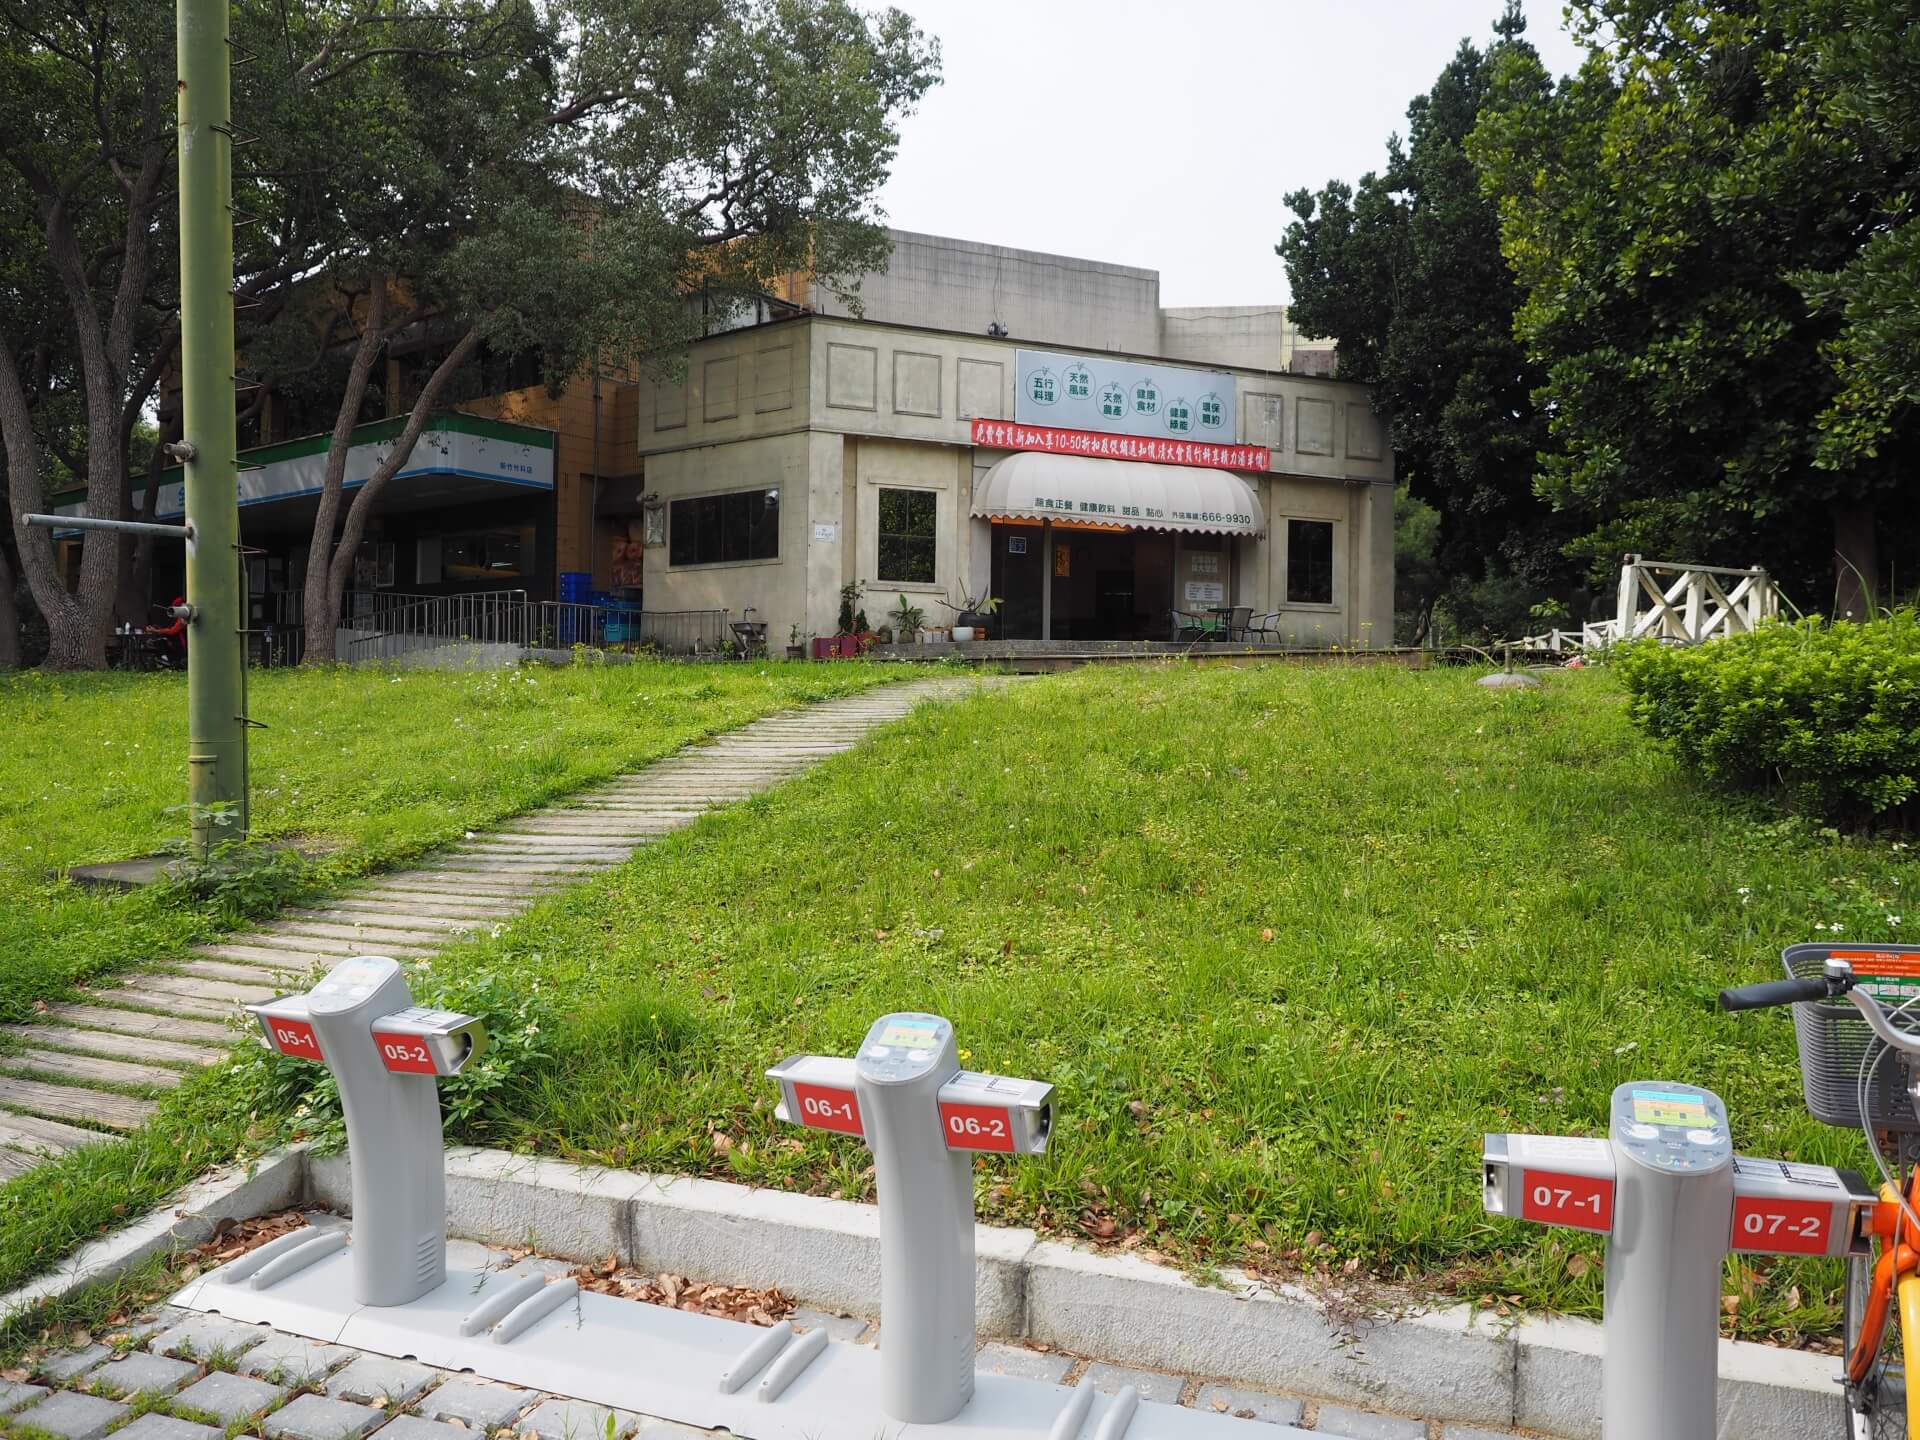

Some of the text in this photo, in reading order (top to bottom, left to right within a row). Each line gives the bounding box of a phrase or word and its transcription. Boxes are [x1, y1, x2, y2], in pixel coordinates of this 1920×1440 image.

[1034, 377, 1054, 389] 五行
[1070, 372, 1089, 384] 天然
[1034, 390, 1054, 402] 料理
[1070, 385, 1089, 396] 風味
[1137, 389, 1155, 400] 健康
[1104, 392, 1122, 404] 天然
[1103, 405, 1122, 416] 農產
[1137, 401, 1155, 412] 食材
[1202, 402, 1220, 413] 環保
[1170, 408, 1188, 419] 健康
[1202, 414, 1220, 425] 簡約
[1170, 419, 1188, 430] 綠能
[1080, 502, 1116, 513] 健康飲料
[1122, 506, 1140, 516] 甜品
[1146, 507, 1164, 518] 點心
[277, 1028, 315, 1049] 05-1
[384, 1043, 428, 1063] 05-2
[804, 1096, 853, 1121] 06-1
[949, 1115, 1006, 1137] 06-2
[1533, 1186, 1601, 1214] 07-1
[1743, 1213, 1821, 1238] 07-2
